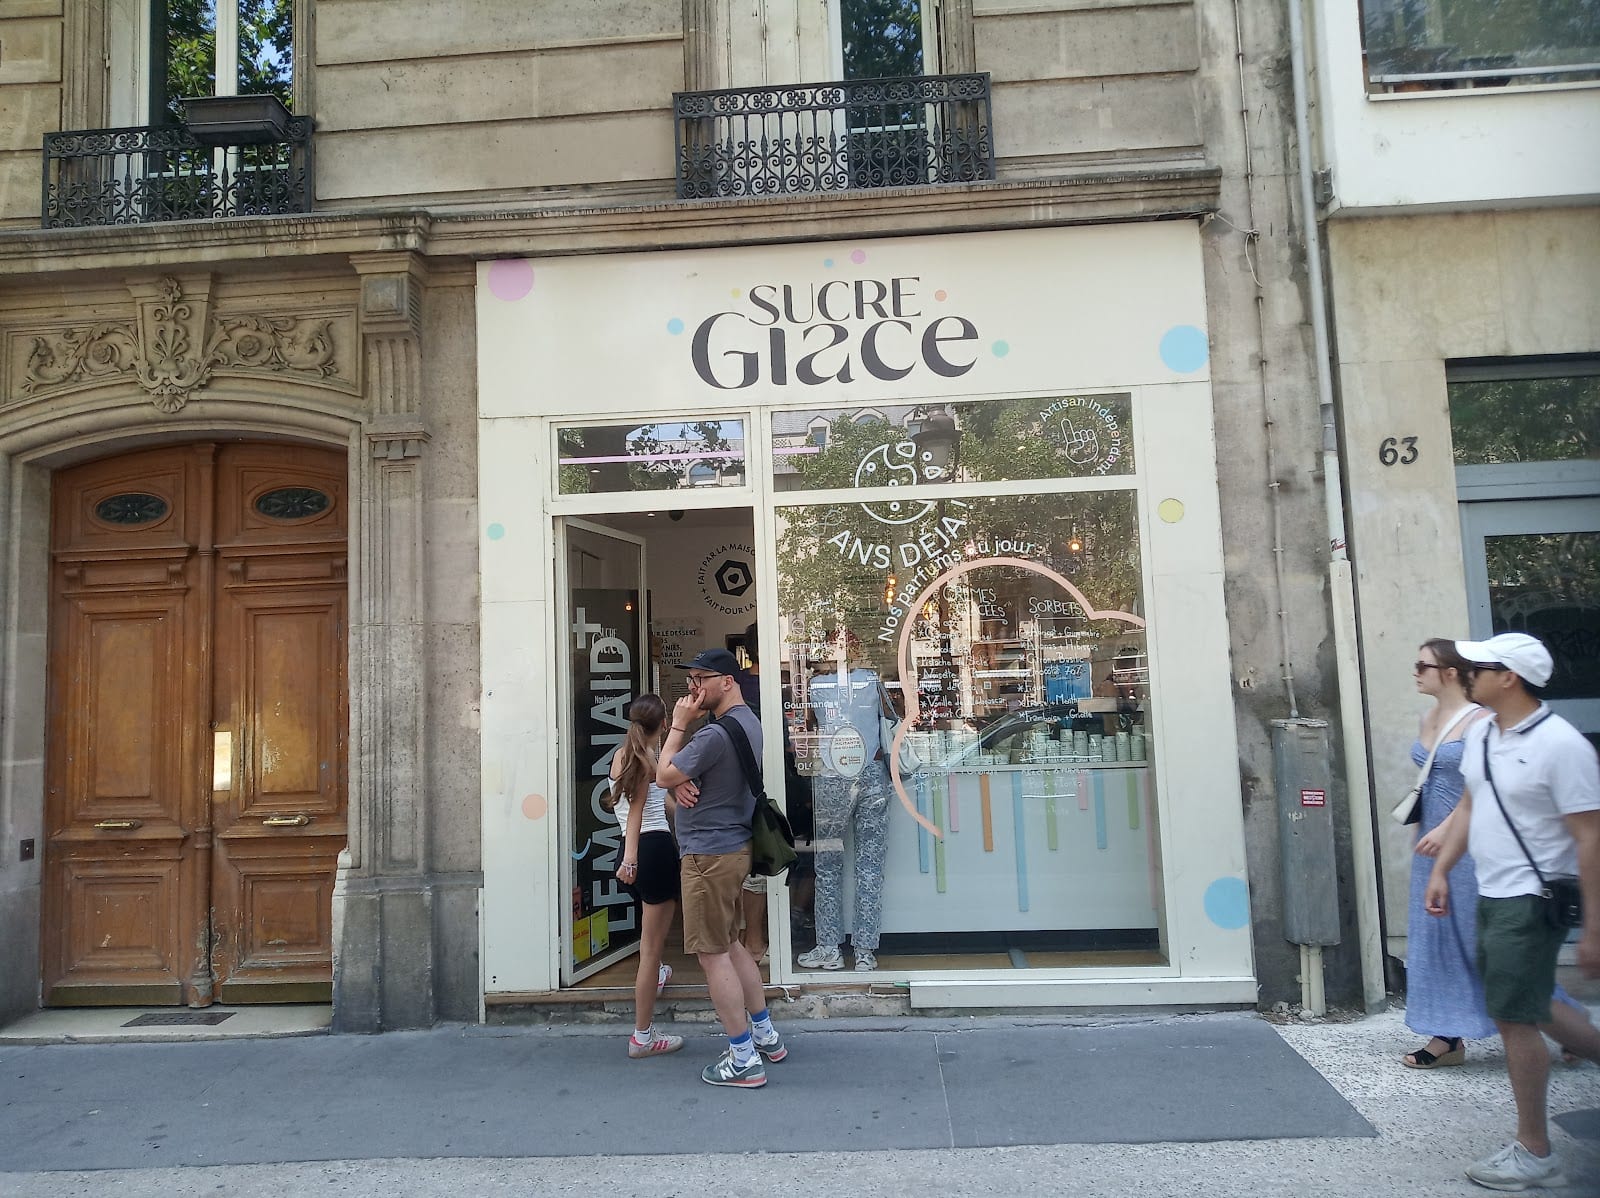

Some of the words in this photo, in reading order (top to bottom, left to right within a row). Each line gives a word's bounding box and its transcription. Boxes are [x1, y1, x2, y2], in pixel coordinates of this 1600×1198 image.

[749, 276, 922, 326] SUCRE
[1040, 398, 1086, 422] Artisan
[1088, 398, 1121, 475] Indépendant
[1379, 436, 1419, 466] 63
[697, 567, 706, 585] FAIT
[702, 551, 717, 568] PAR
[716, 545, 727, 554] LA
[729, 543, 755, 557] MAISO
[826, 530, 891, 569] ANS
[704, 595, 719, 610] FAIT
[719, 605, 744, 615] POUR
[744, 603, 756, 612] LA
[878, 606, 903, 642] Nos
[896, 549, 962, 607] parfums
[1029, 596, 1083, 616] SORBETS
[720, 1066, 734, 1080] N
